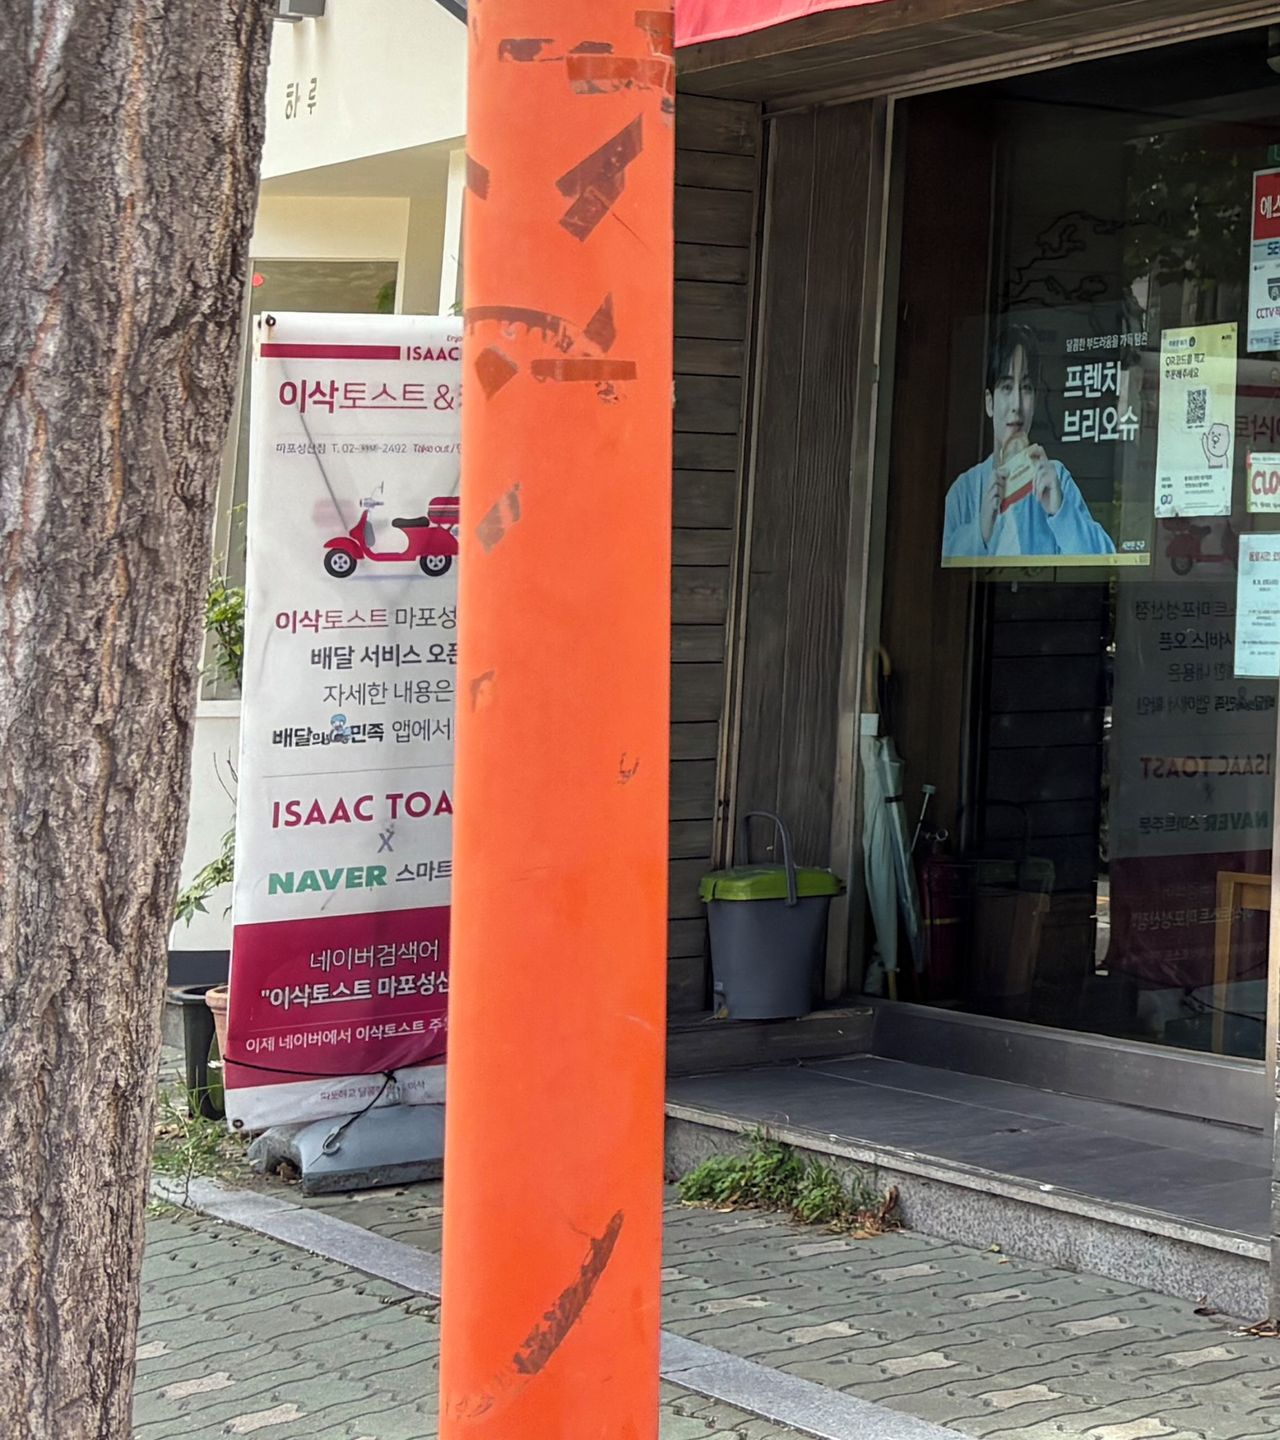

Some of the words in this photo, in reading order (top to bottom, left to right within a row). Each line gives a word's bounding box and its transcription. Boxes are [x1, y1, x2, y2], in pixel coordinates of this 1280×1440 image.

[406, 346, 461, 361] ISAAC
[1064, 361, 1121, 398] 프렌치
[279, 379, 428, 414] 이삭토스트
[433, 384, 454, 410] &
[1061, 406, 1139, 443] 브리오슈
[275, 609, 389, 634] 이삭토스트
[310, 645, 355, 670] 배달
[360, 643, 422, 668] 서비스
[323, 681, 389, 707] 자세한
[394, 679, 455, 704] 내용은
[392, 718, 452, 743] 앱에서
[272, 795, 374, 828] ISAAC
[268, 864, 388, 895] NAVER
[310, 939, 439, 972] 네이버검색어
[261, 979, 373, 1010] "이삭토스트
[246, 1036, 275, 1053] 이제
[279, 1027, 352, 1051] 네이버에서
[355, 1019, 426, 1042] 이삭토스트
